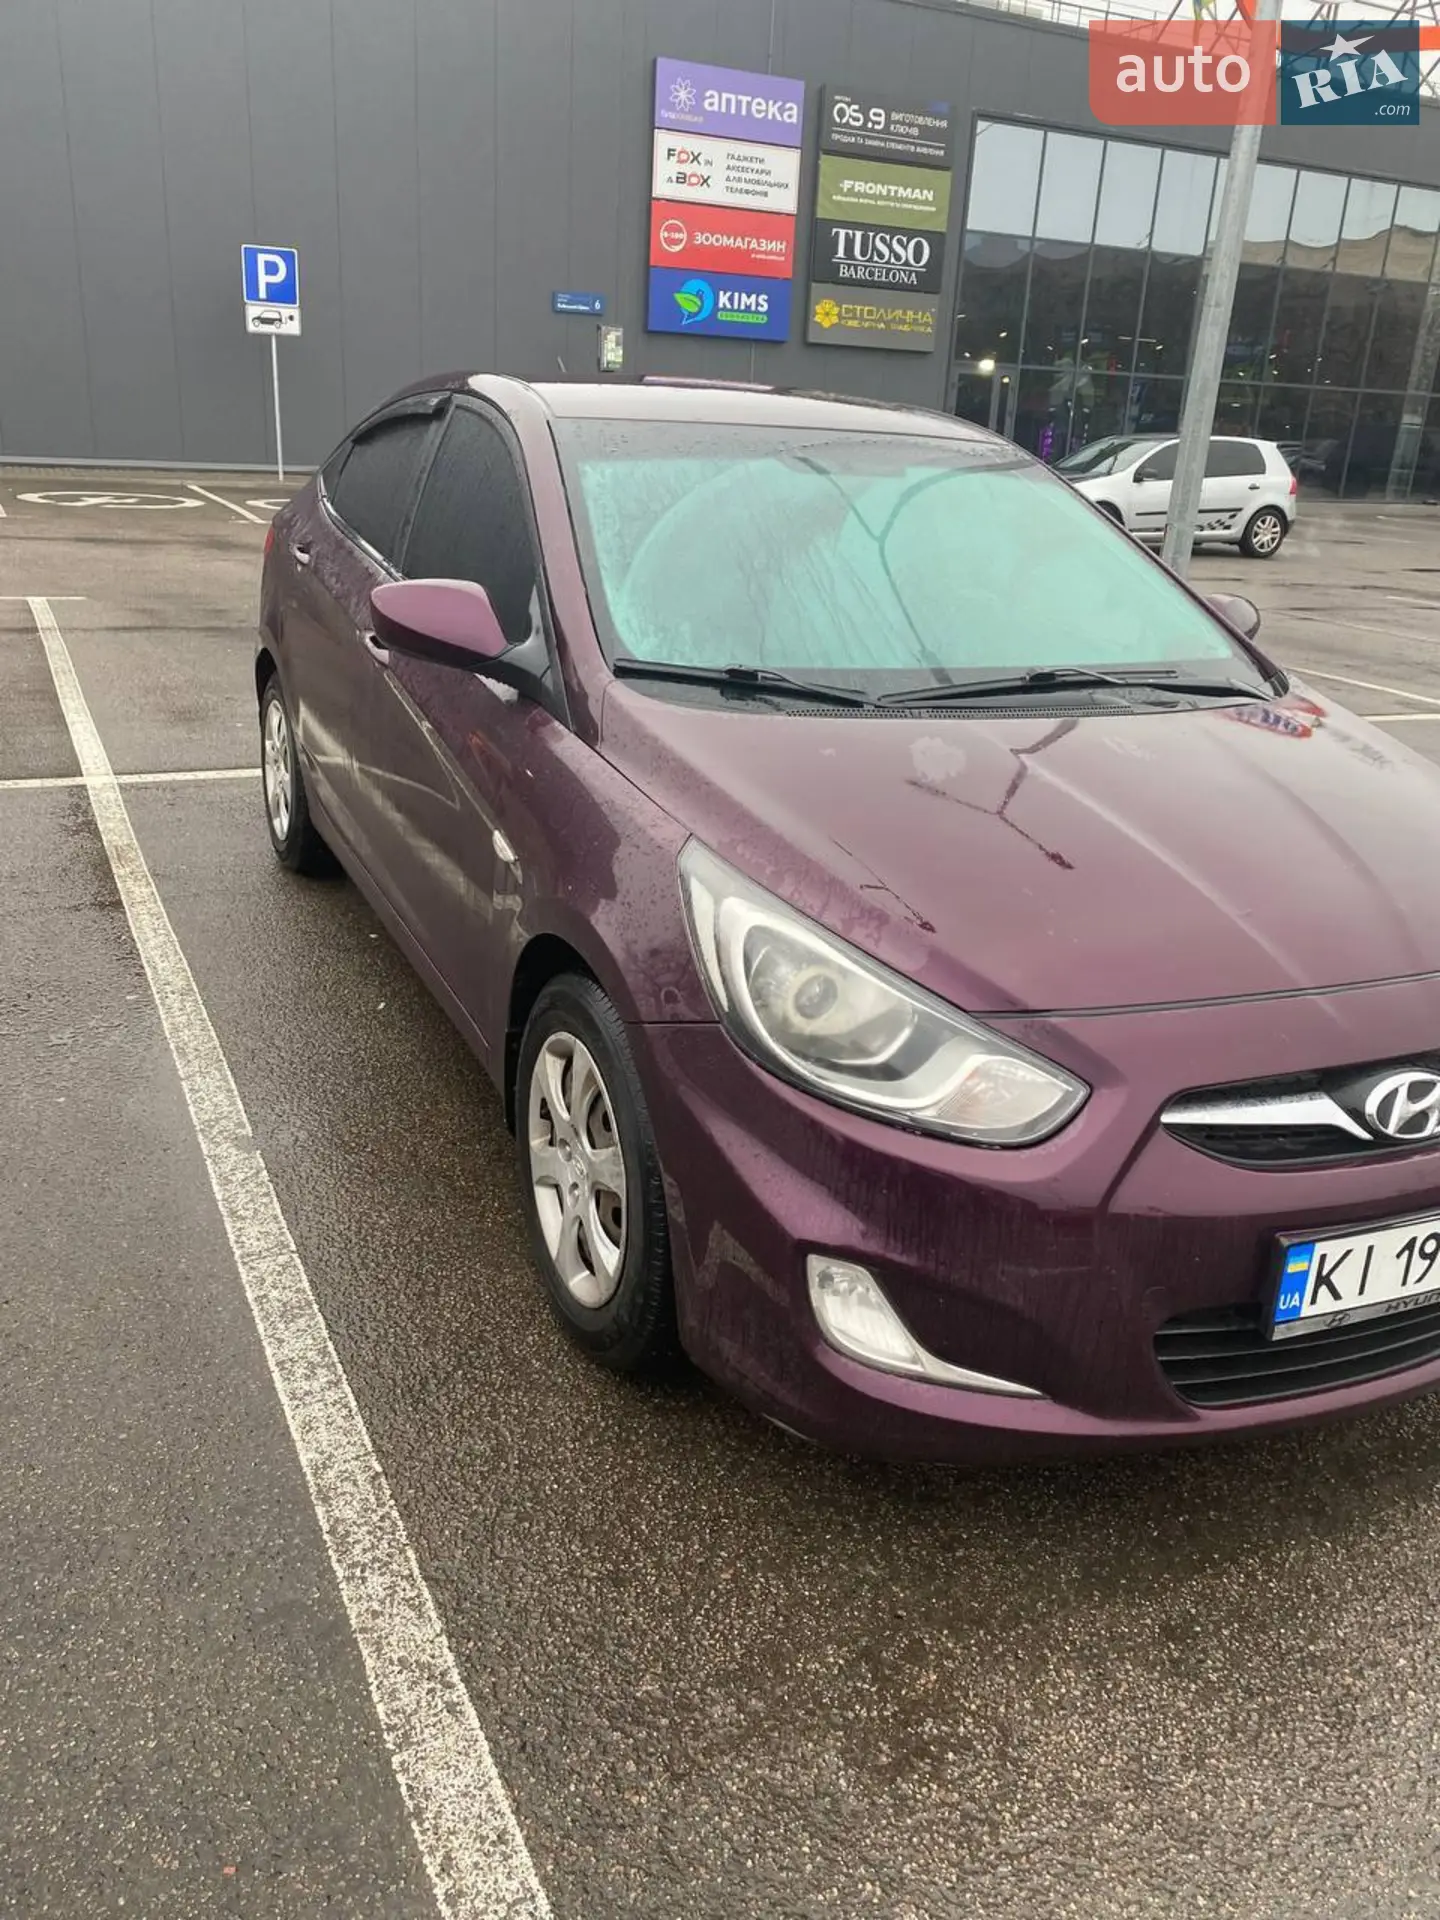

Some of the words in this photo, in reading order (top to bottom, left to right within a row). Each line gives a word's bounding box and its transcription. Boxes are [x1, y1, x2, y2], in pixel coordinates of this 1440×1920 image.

[703, 88, 798, 124] аптека
[667, 147, 702, 166] FOX
[726, 152, 765, 164] ГАДЖЕТИ
[675, 171, 711, 188] BOX
[725, 164, 772, 176] АКСЕСУАРИ
[725, 175, 743, 184] ДЛЯ
[743, 177, 789, 189] МОБІЛЬНИХ
[725, 185, 769, 198] ТЕЛЕФОНІВ
[841, 179, 934, 202] FRONTMAN
[693, 231, 787, 253] ЗООМАГАЗИН
[830, 227, 931, 267] TUSSO
[257, 252, 287, 299] P
[839, 263, 918, 285] BARCELONA
[594, 299, 601, 310] 6
[718, 290, 769, 312] KIMS
[841, 303, 933, 324] СТОЛИЧНА
[1310, 1244, 1375, 1306] KI
[1279, 1292, 1300, 1309] UA
